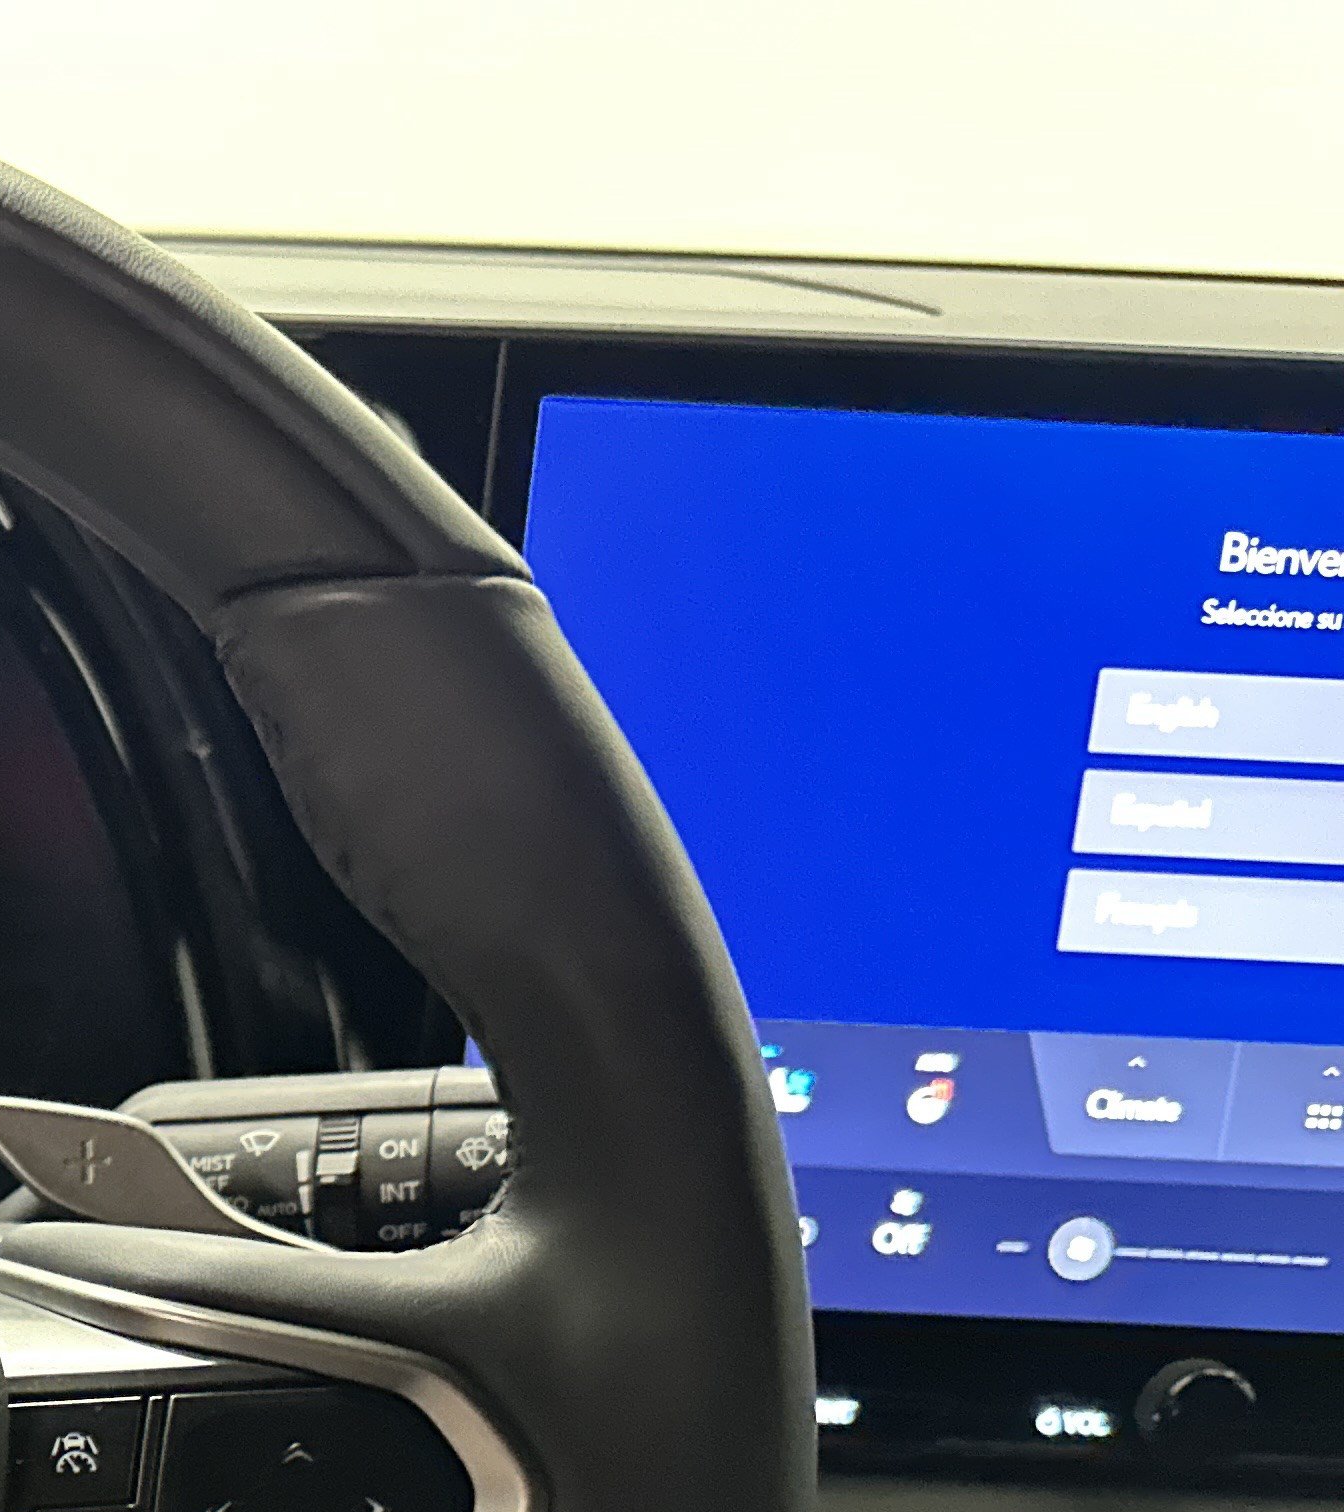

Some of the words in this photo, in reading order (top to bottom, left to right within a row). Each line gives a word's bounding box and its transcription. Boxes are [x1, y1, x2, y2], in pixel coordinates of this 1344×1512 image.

[1219, 531, 1344, 577] Bienve
[378, 1138, 418, 1160] ON
[190, 1153, 237, 1172] MIST
[379, 1180, 421, 1203] INT
[378, 1222, 429, 1241] OFF
